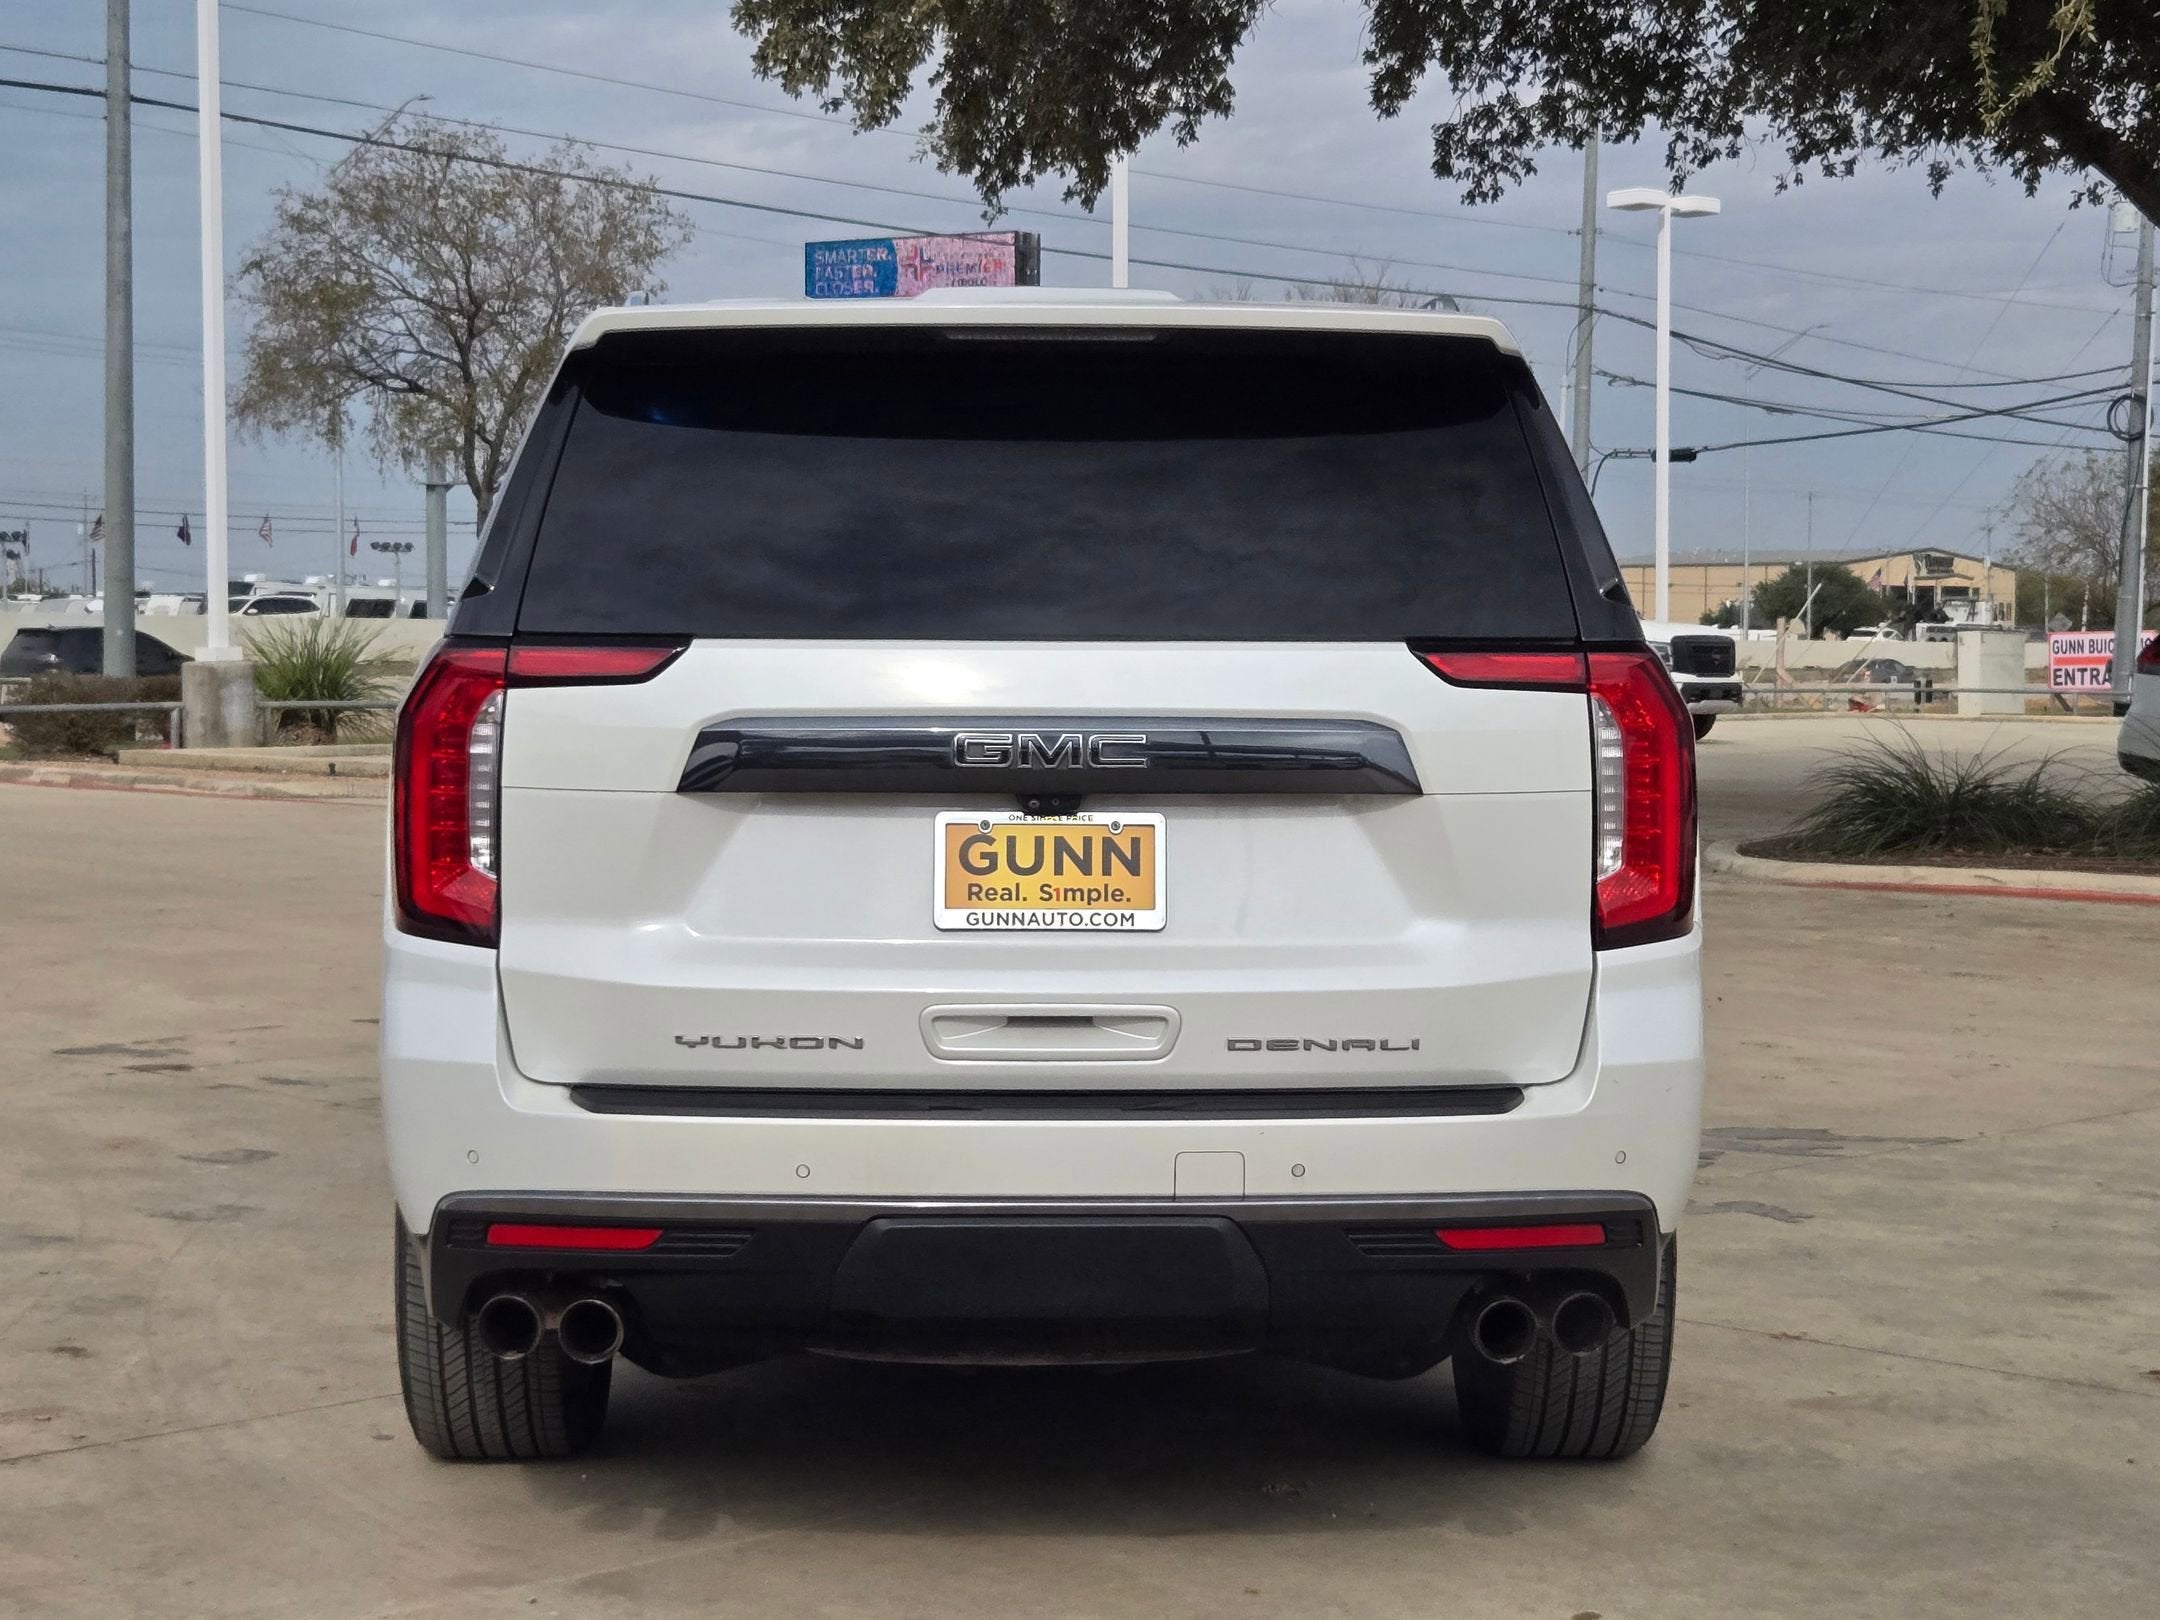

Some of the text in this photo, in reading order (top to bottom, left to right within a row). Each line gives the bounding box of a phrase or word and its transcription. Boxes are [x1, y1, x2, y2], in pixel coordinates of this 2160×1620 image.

[2052, 638, 2115, 655] GUNN BUIC
[2053, 667, 2112, 686] ENTRA
[954, 733, 1148, 769] GMC
[1008, 814, 1028, 822] ONE
[958, 833, 1141, 877] GUNN
[967, 882, 1028, 902] Real.
[966, 912, 1135, 927] GUNNAUTO.COM
[675, 1035, 863, 1050] YUKON
[1227, 1038, 1420, 1052] DENALI
